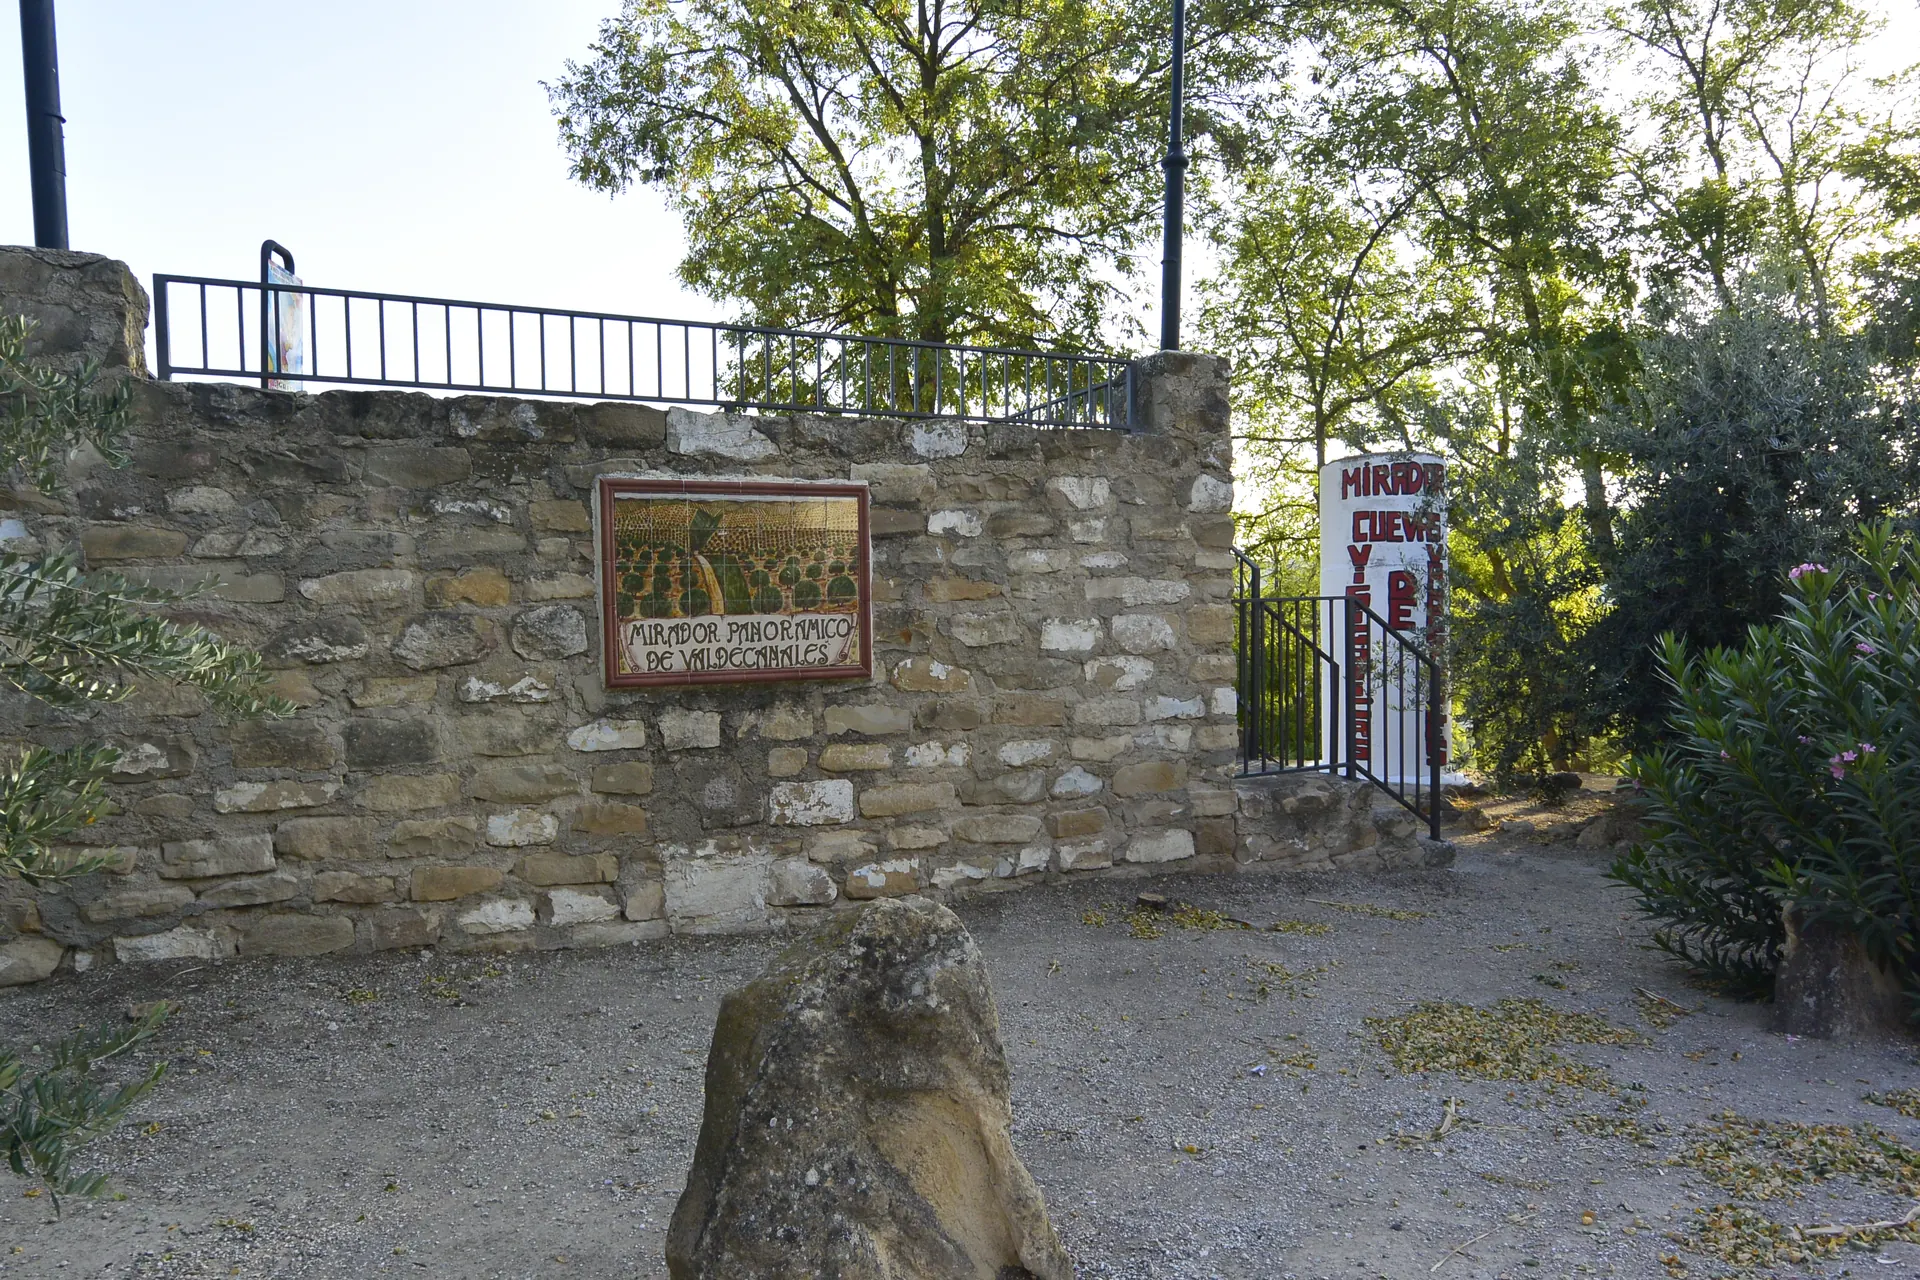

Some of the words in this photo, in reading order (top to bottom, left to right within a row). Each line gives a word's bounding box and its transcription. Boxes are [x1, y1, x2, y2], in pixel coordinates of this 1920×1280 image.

[628, 622, 721, 648] MIRADOR
[727, 618, 851, 646] PANORAMICO
[646, 651, 675, 672] DE
[679, 643, 829, 672] VALDECANALES
